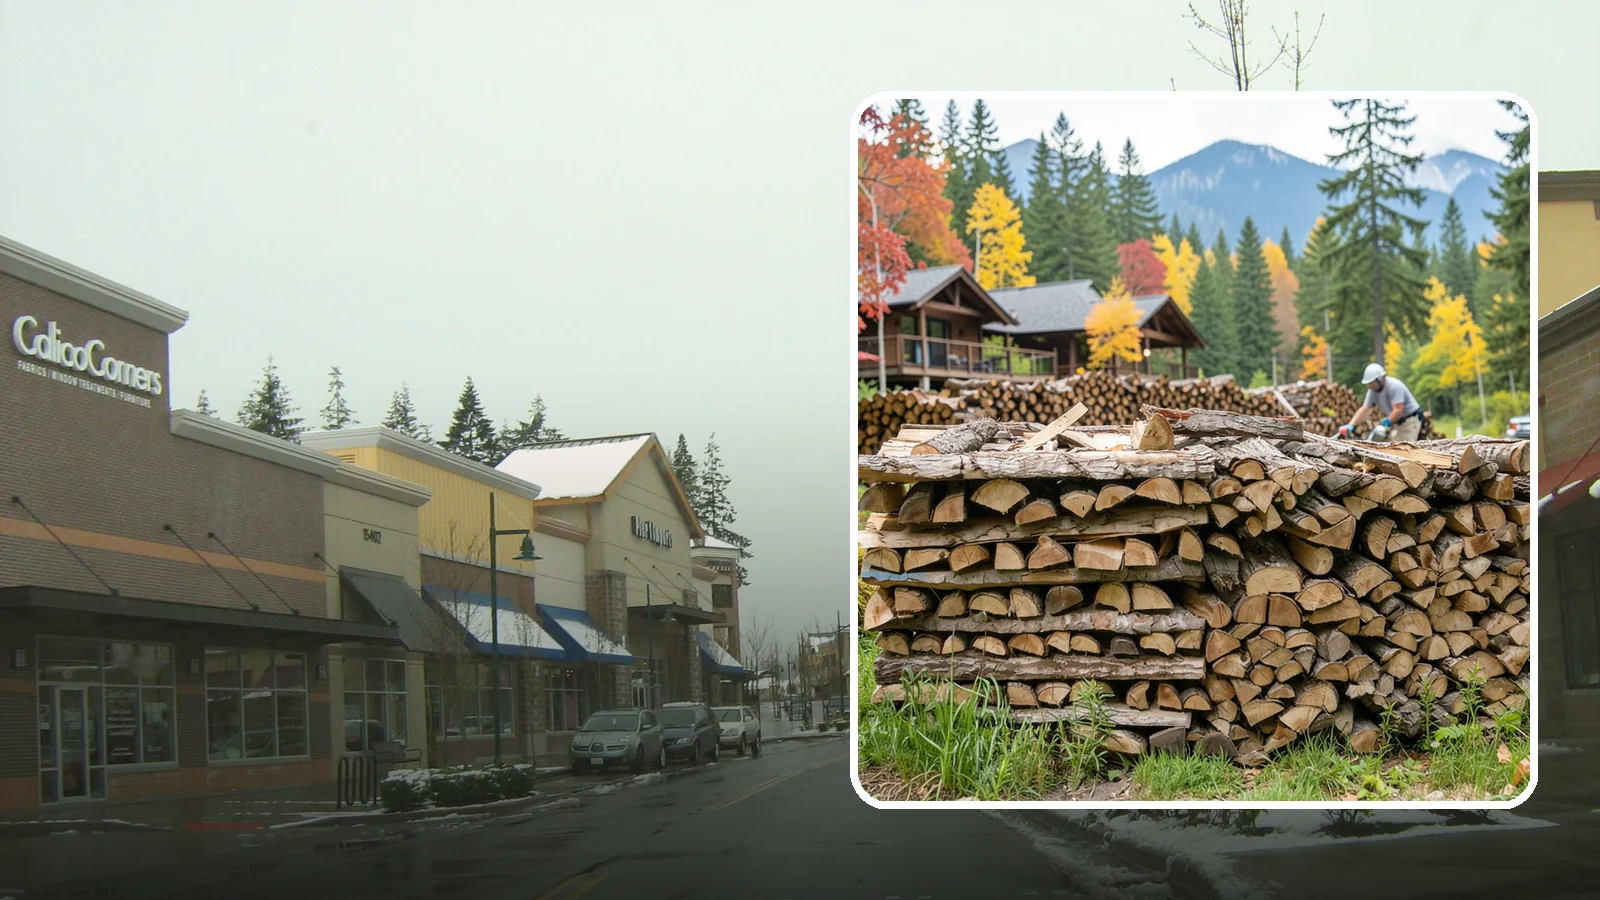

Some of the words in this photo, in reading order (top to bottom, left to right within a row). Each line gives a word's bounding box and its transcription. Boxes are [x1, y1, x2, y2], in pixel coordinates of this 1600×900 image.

[17, 360, 47, 378] FABRICS
[51, 370, 78, 387] WINDOW
[78, 378, 117, 398] TREATMENTS
[120, 391, 151, 409] FURNITURE
